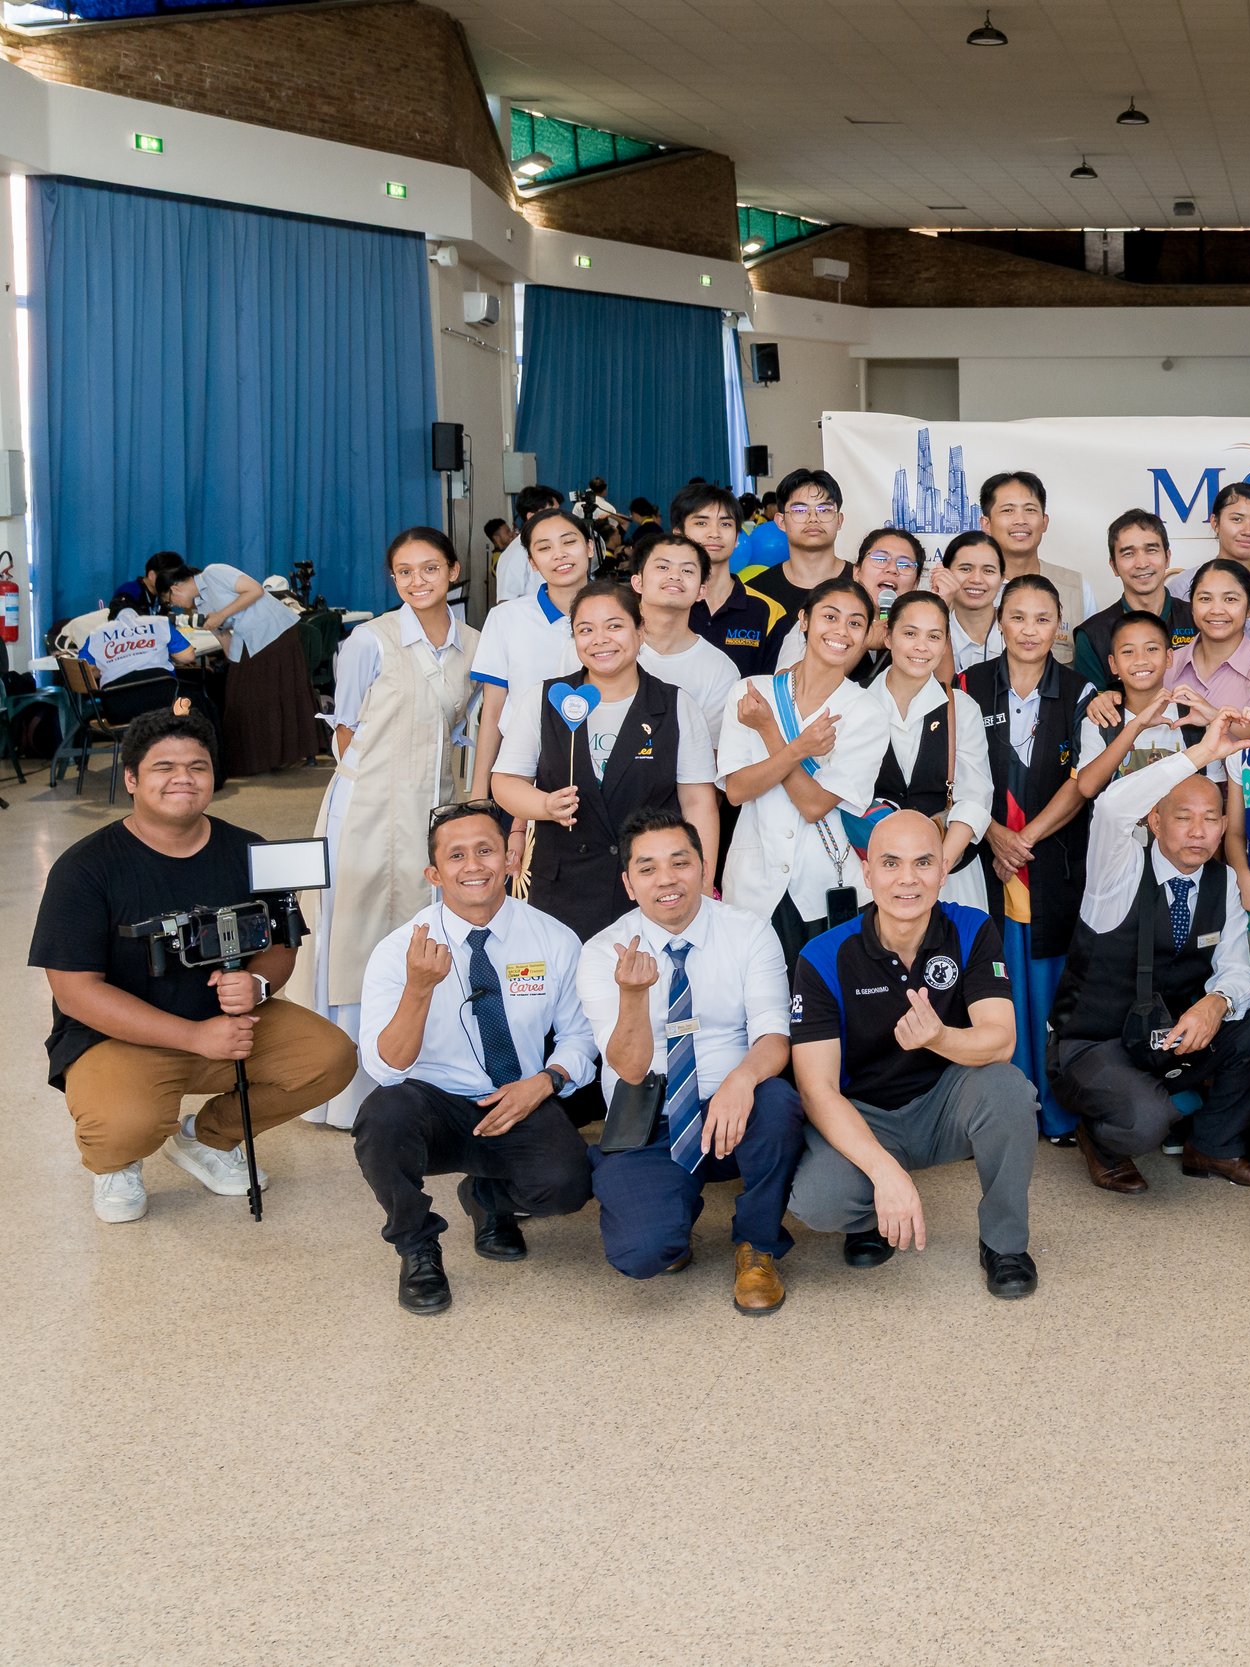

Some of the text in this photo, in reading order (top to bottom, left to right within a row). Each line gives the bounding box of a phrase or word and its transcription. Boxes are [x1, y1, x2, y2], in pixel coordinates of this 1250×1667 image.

[103, 623, 156, 642] MCGI
[726, 628, 761, 641] MCGI
[104, 638, 156, 660] Cares
[510, 981, 545, 994] Cares
